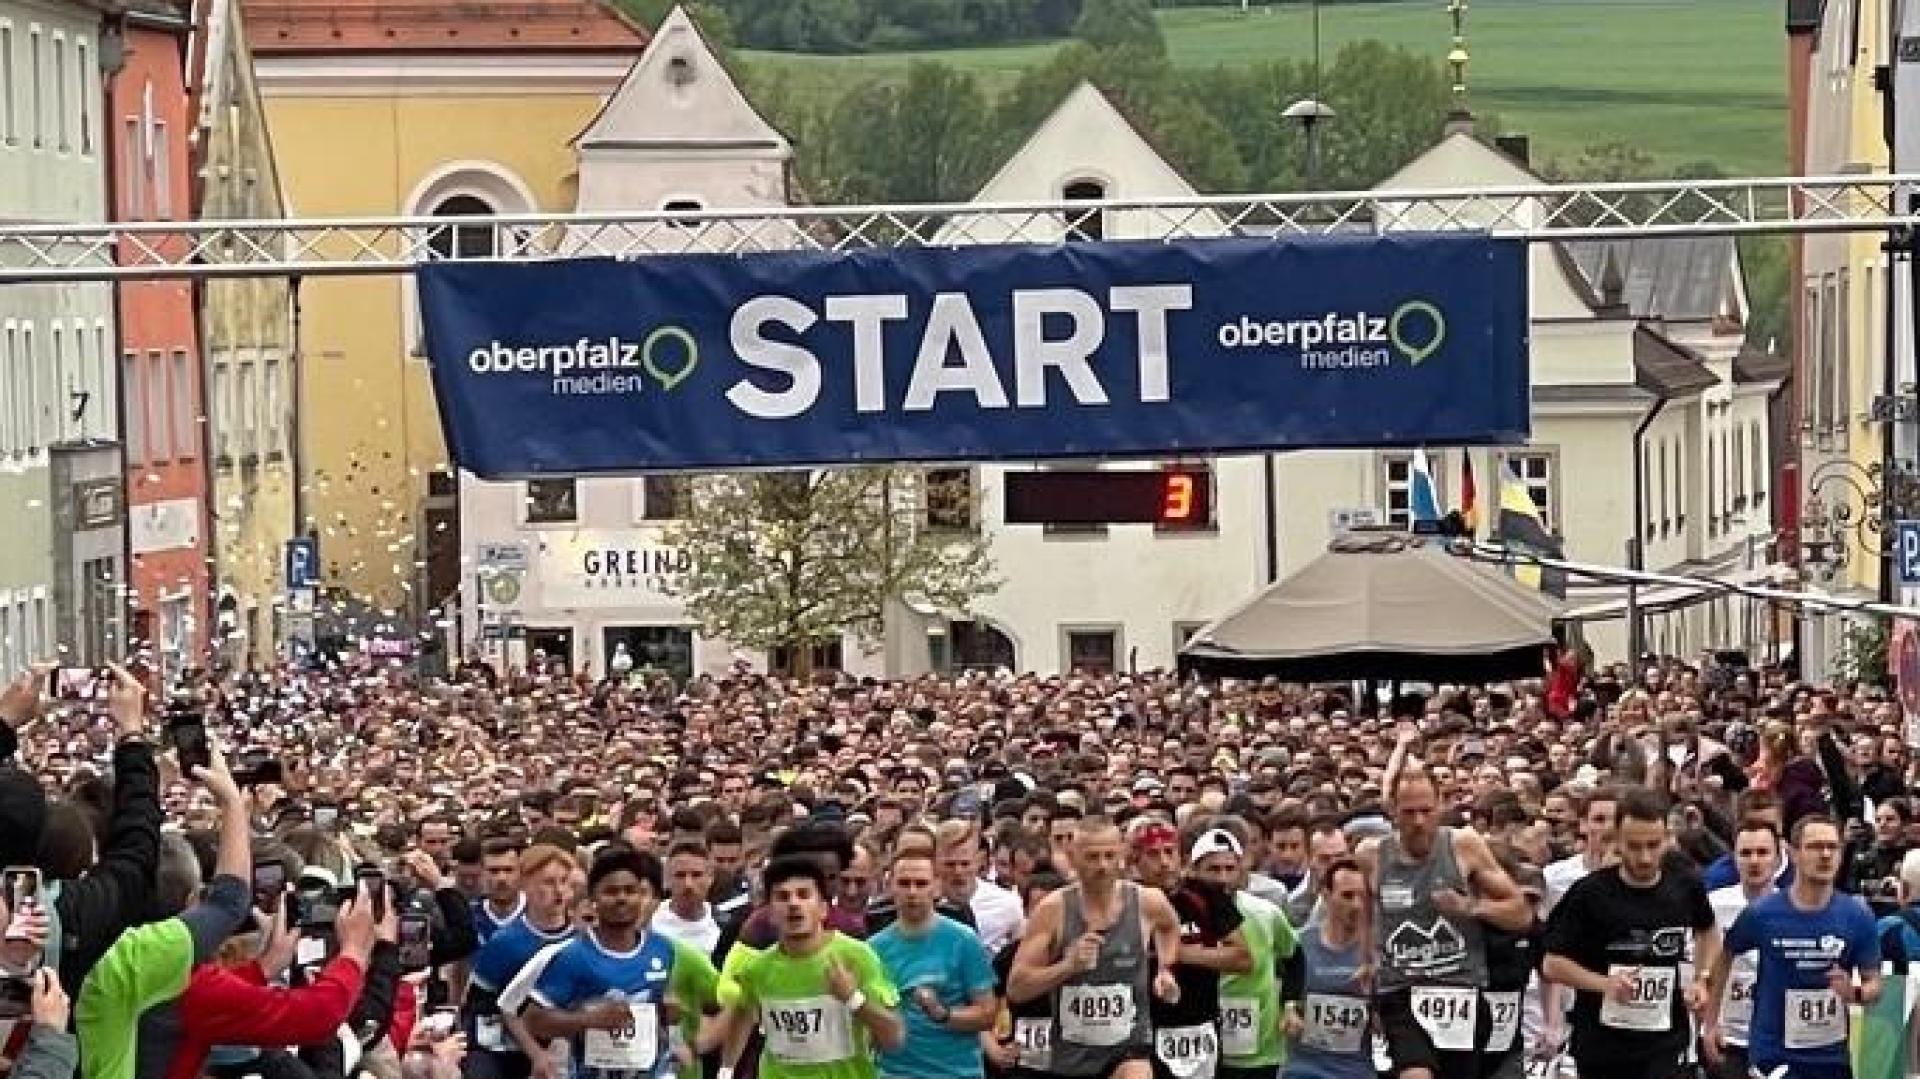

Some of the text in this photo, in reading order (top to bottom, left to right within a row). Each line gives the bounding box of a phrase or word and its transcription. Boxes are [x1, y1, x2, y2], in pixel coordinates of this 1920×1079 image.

[1218, 311, 1388, 350] oberpfalz
[469, 336, 640, 376] oberpfalz
[725, 283, 1193, 419] START
[1300, 346, 1390, 369] medien
[552, 370, 643, 394] medien
[1163, 475, 1193, 518] 3
[292, 547, 309, 586] P
[1904, 530, 1918, 577] P
[768, 1008, 822, 1035] 1987
[1068, 994, 1126, 1019] 4893
[1418, 996, 1471, 1021] 4914
[1800, 997, 1836, 1021] 814
